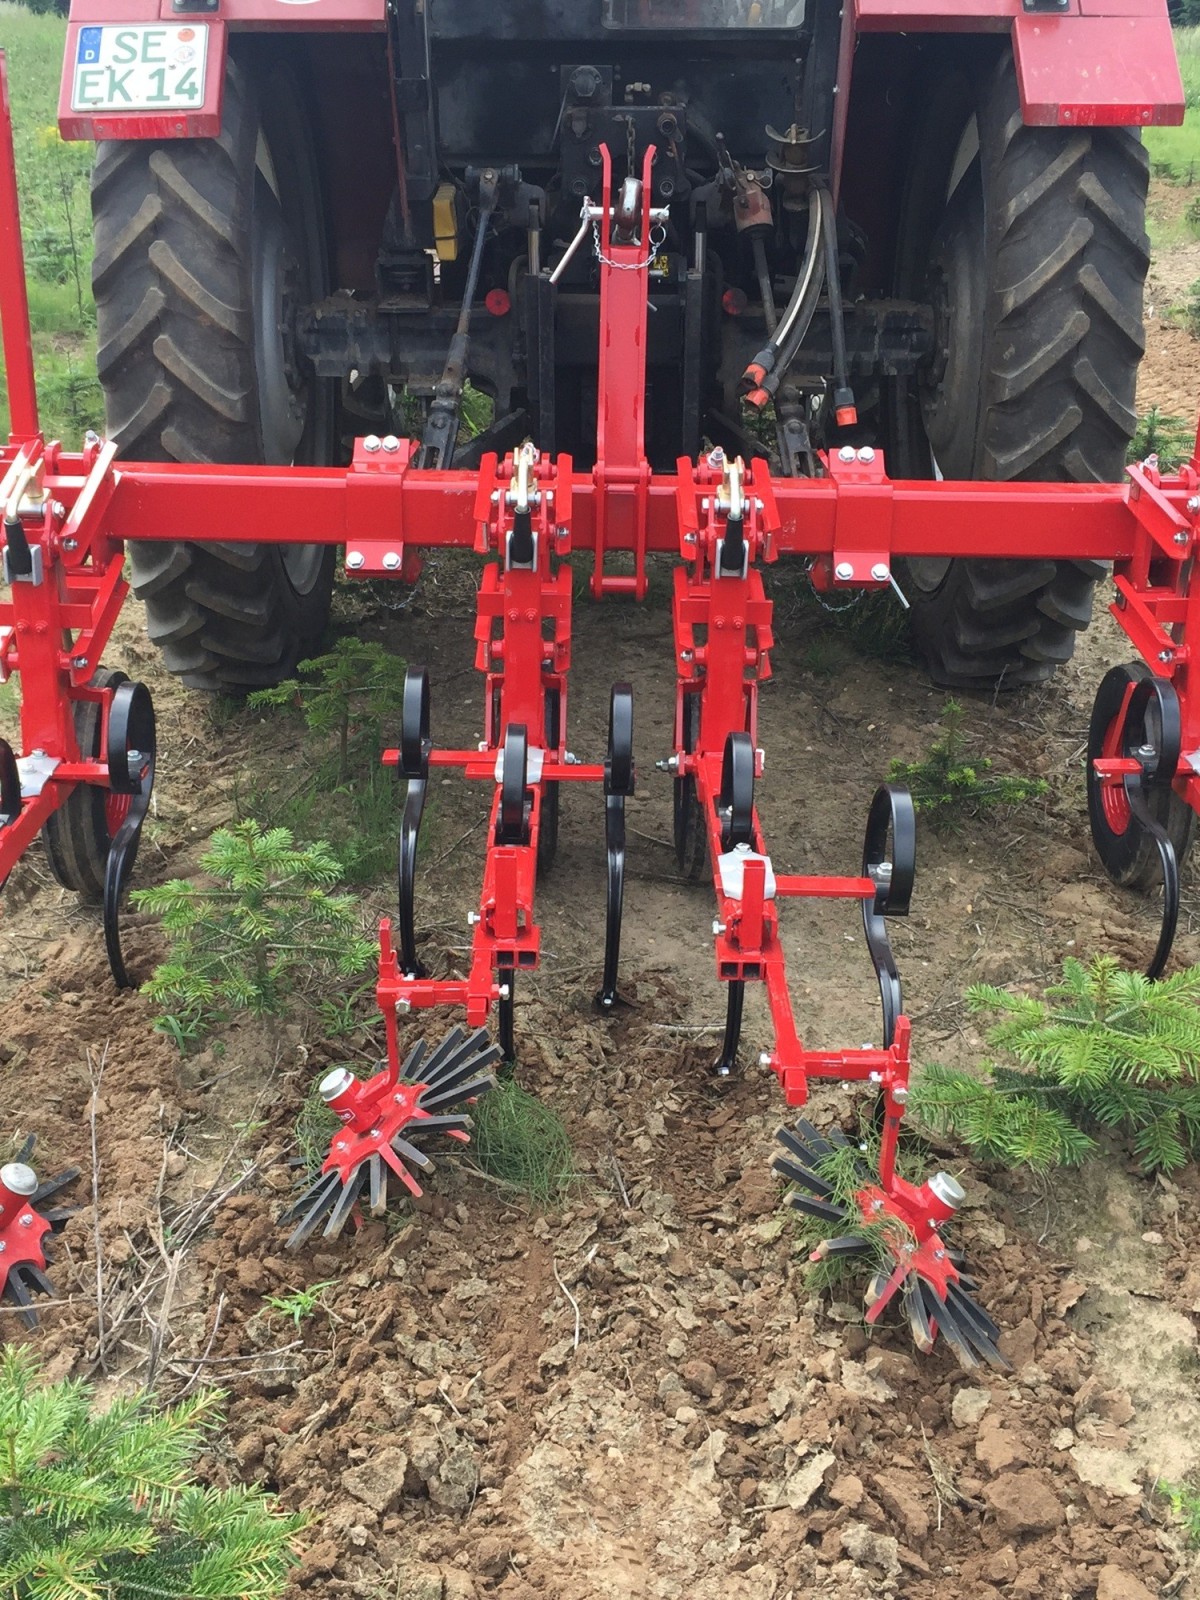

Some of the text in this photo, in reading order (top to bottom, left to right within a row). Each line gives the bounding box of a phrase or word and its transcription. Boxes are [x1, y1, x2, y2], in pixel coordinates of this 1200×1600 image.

[84, 50, 95, 60] D
[112, 31, 167, 64] SE
[78, 67, 199, 104] EK 14
